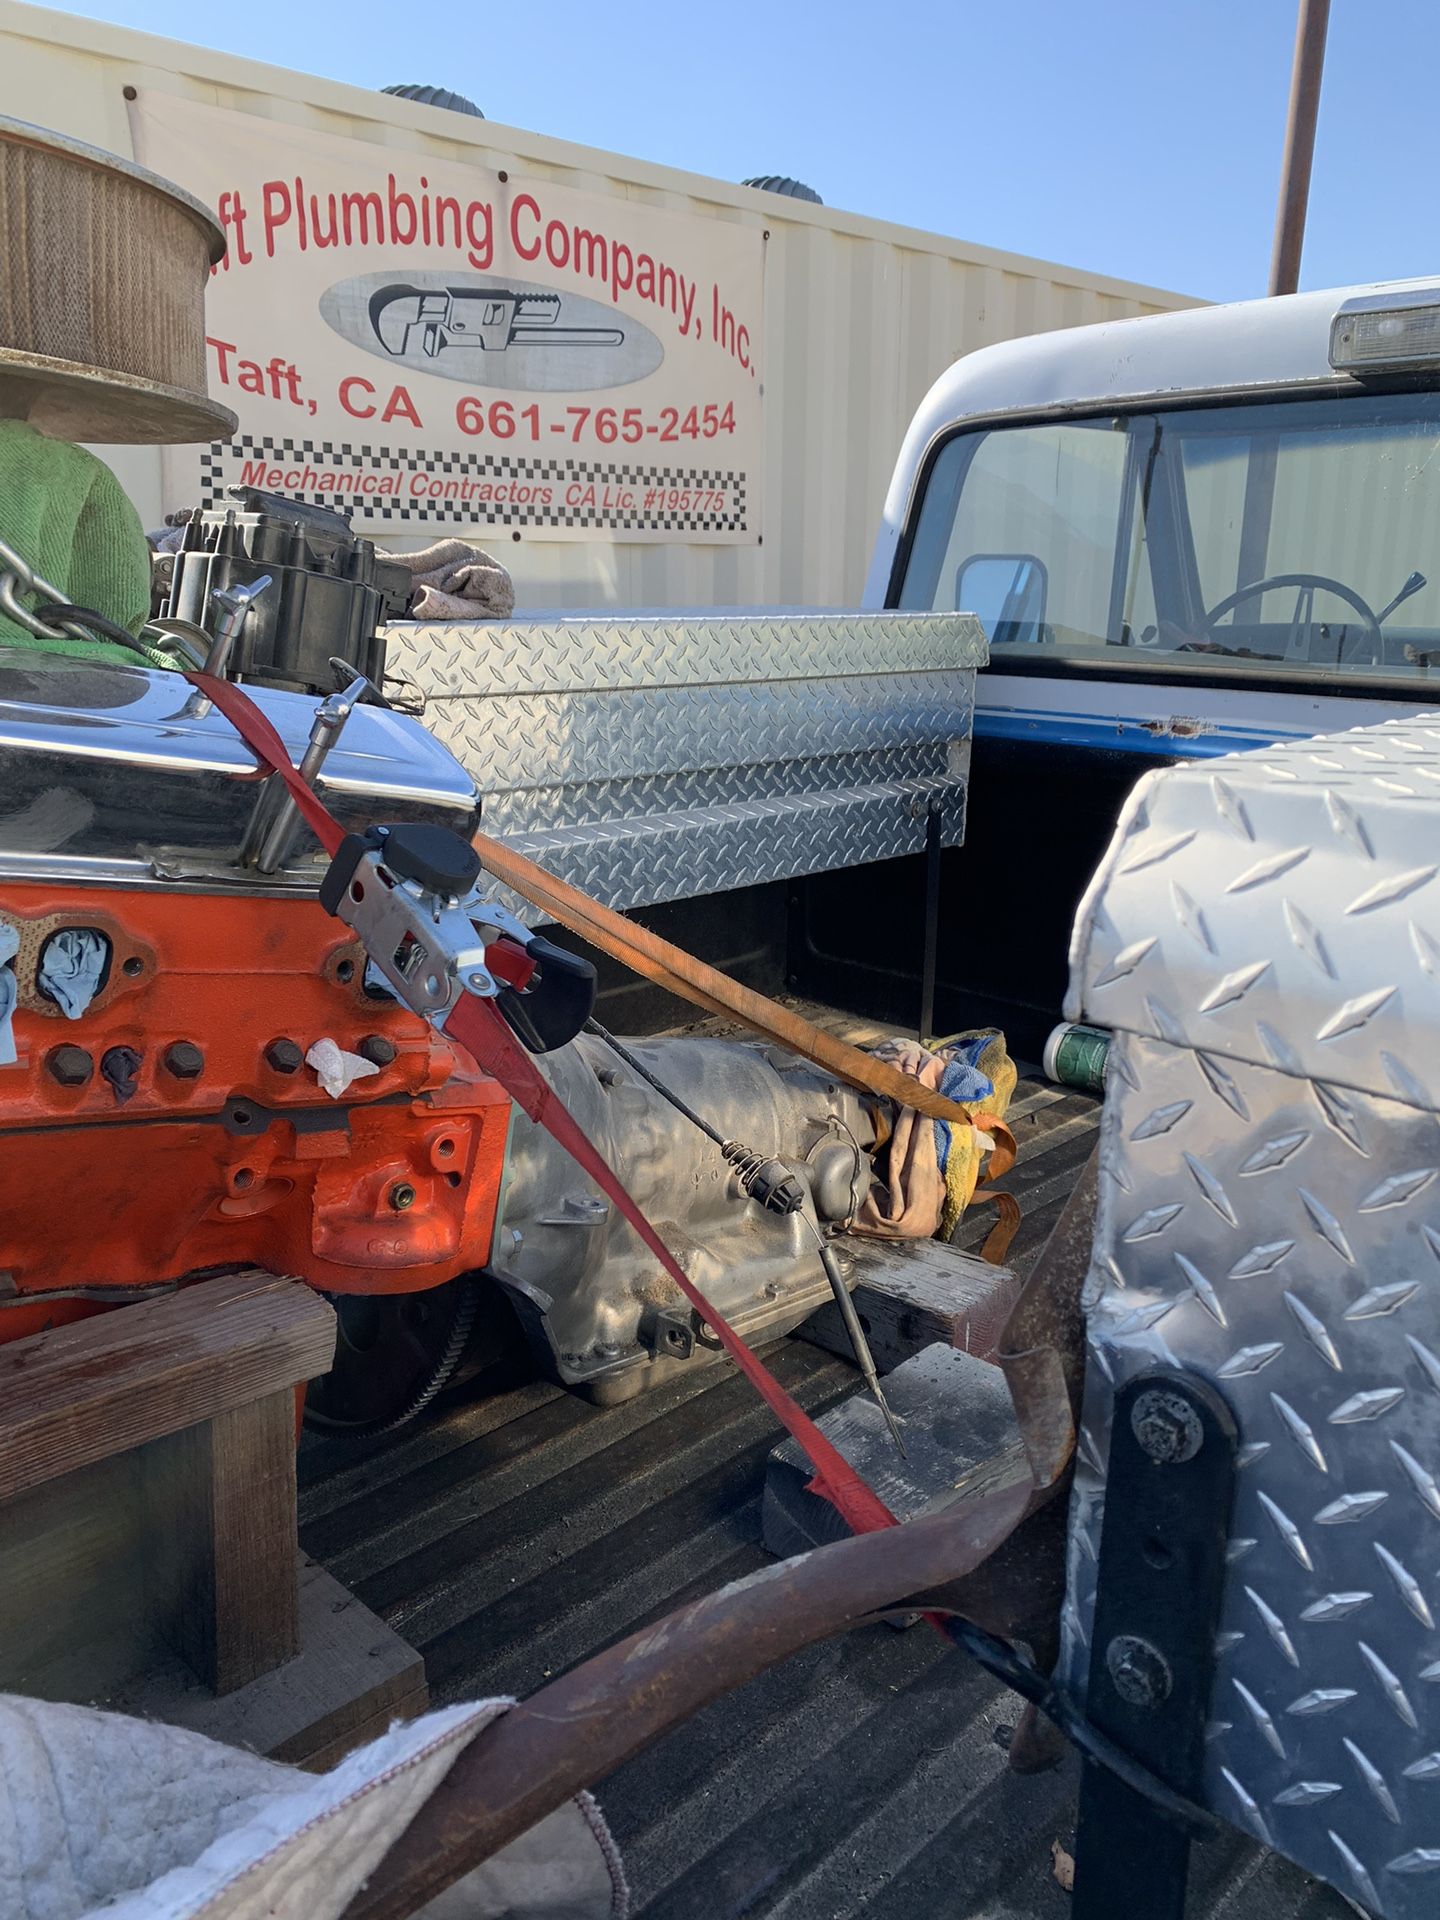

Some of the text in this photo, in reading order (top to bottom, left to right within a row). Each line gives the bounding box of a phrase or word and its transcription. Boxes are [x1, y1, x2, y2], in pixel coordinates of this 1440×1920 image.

[210, 173, 755, 378] ft Plumbing Company, Inc.
[206, 336, 737, 444] Taft, CA 661-765-2454
[239, 460, 725, 512] Mechanical Contractors CA Lic. #195775
